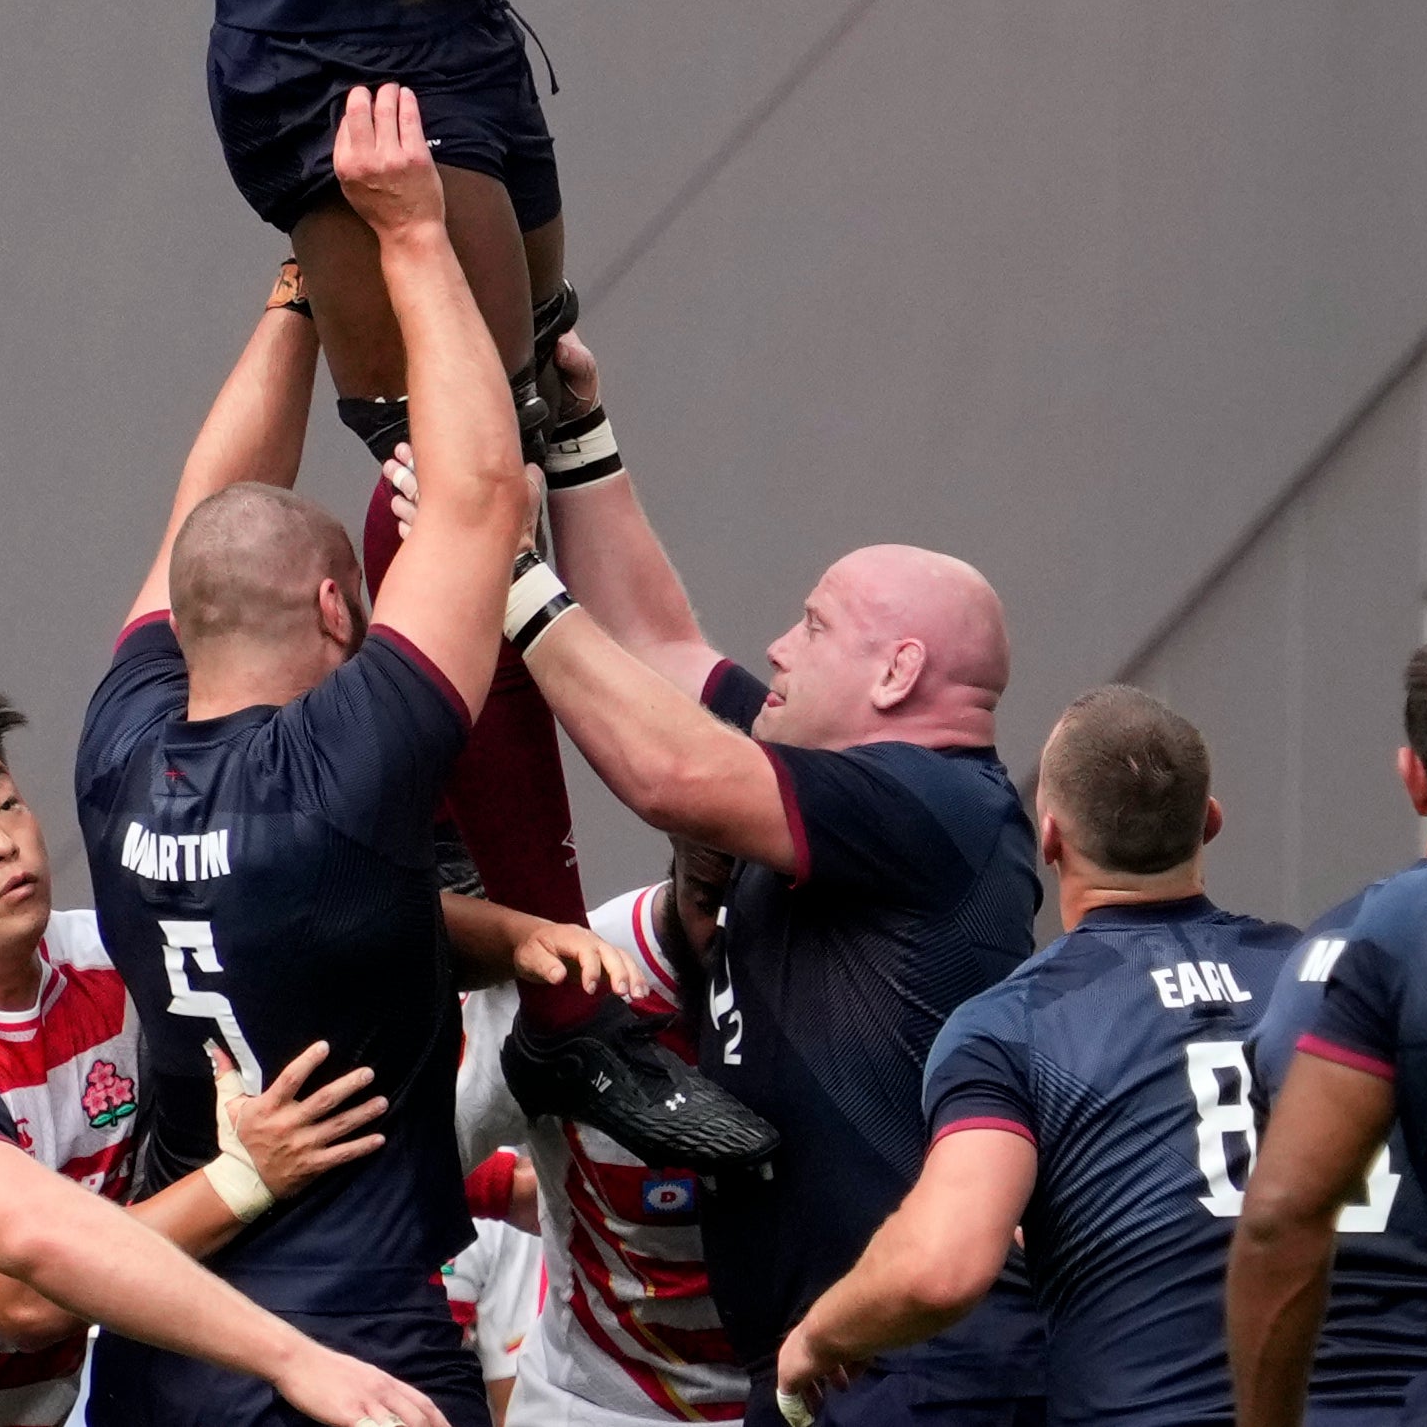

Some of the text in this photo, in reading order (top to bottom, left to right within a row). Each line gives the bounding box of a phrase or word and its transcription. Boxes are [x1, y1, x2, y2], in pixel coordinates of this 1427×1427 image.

[121, 821, 231, 882] MARTIN
[158, 920, 263, 1097] 5
[1151, 960, 1252, 1009] EARL
[1186, 1040, 1257, 1217] 8
